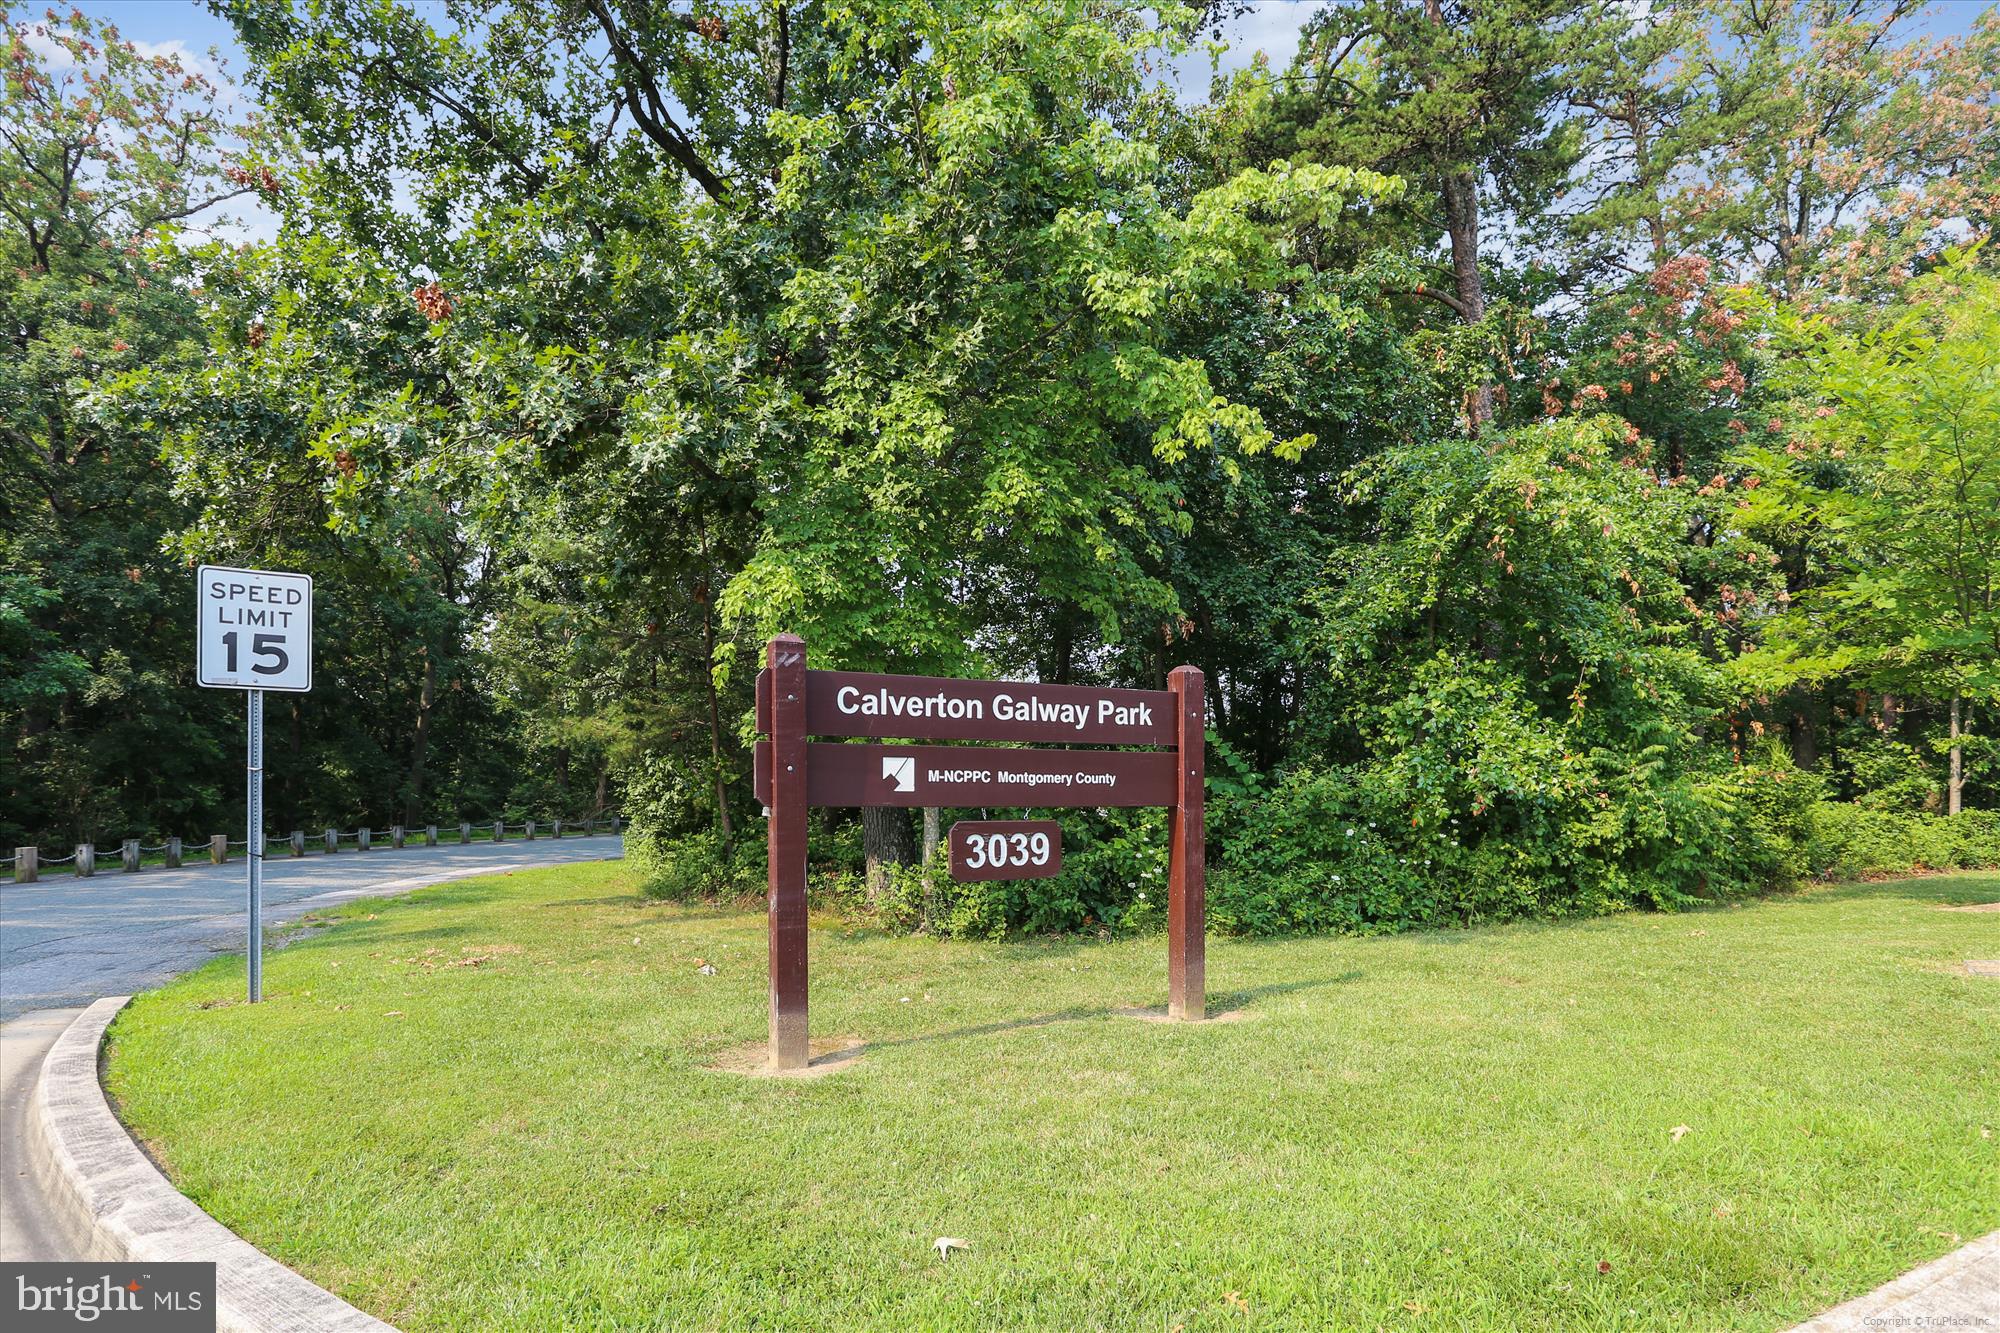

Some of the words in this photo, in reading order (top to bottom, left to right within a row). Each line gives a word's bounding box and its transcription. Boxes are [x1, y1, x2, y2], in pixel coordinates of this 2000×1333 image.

[210, 582, 302, 605] SPEED
[218, 606, 293, 628] LIMIT
[222, 631, 289, 675] 15
[836, 686, 983, 720] Calverton
[992, 694, 1090, 730] Galway
[1098, 699, 1153, 727] Park
[927, 769, 991, 783] M-NCPPC
[997, 770, 1073, 787] Montgomery
[1075, 771, 1117, 787] County
[966, 832, 1050, 869] 3039
